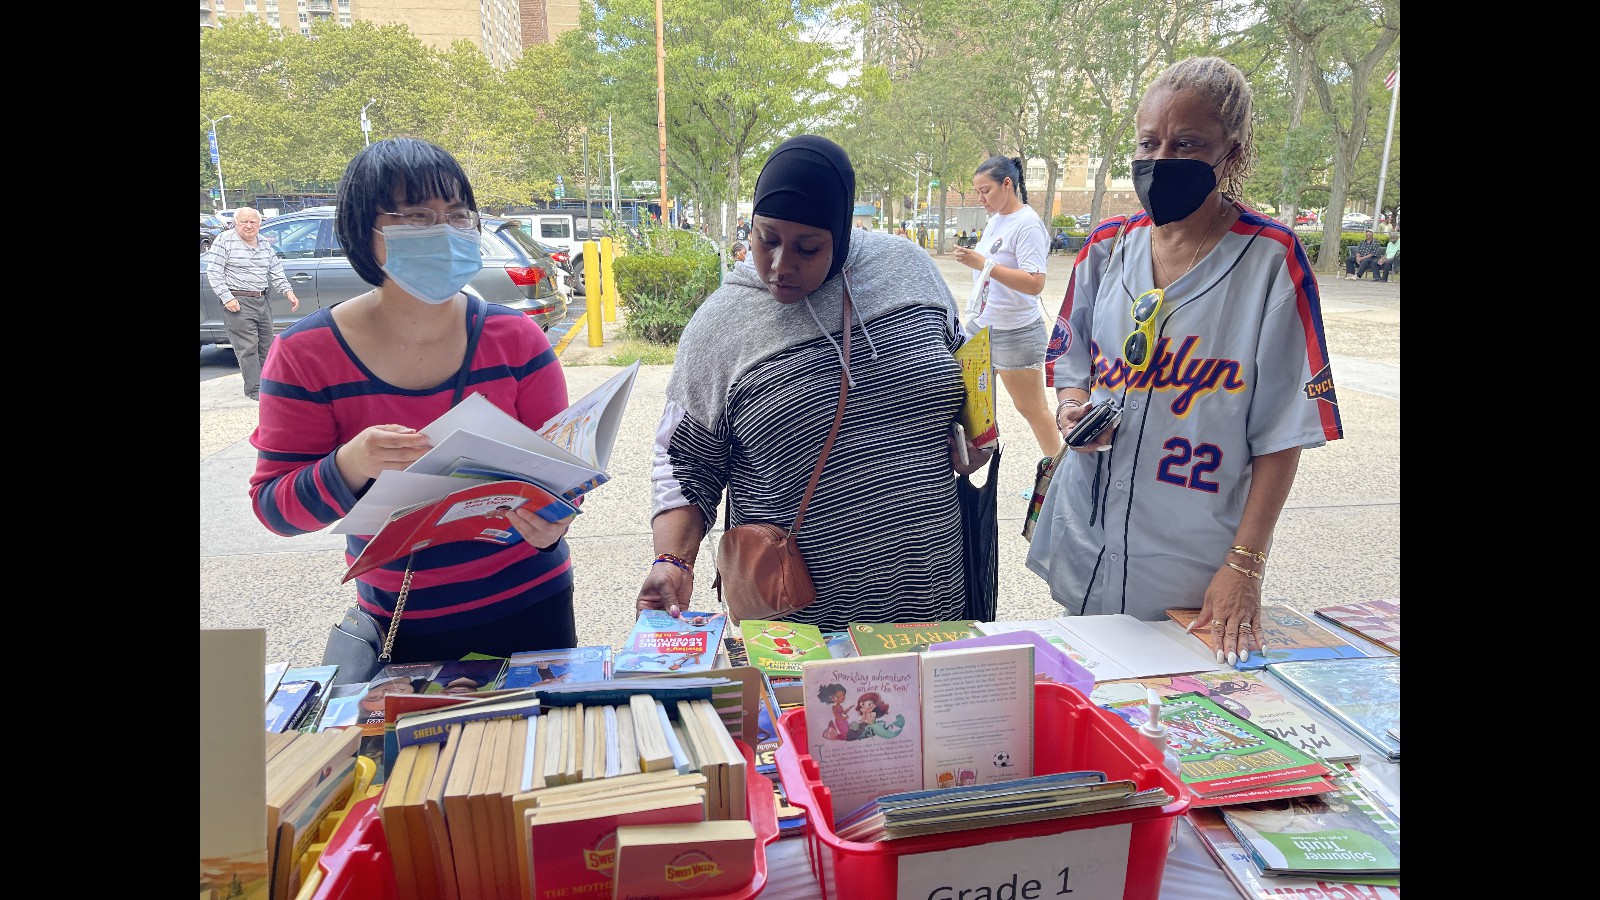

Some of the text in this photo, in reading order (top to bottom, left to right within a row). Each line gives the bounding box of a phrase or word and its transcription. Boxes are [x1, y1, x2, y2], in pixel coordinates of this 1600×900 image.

[1156, 436, 1223, 493] 22
[831, 670, 912, 685] Sparkling adventures
[856, 682, 878, 693] under
[880, 682, 892, 693] the
[413, 726, 443, 739] SHEILA
[1299, 733, 1332, 750] MY
[1293, 840, 1346, 852] Truth
[1303, 850, 1377, 862] Sojourner
[667, 863, 716, 879] SWEET VALLEY
[928, 866, 1074, 900] Grade 1
[544, 888, 568, 899] THE
